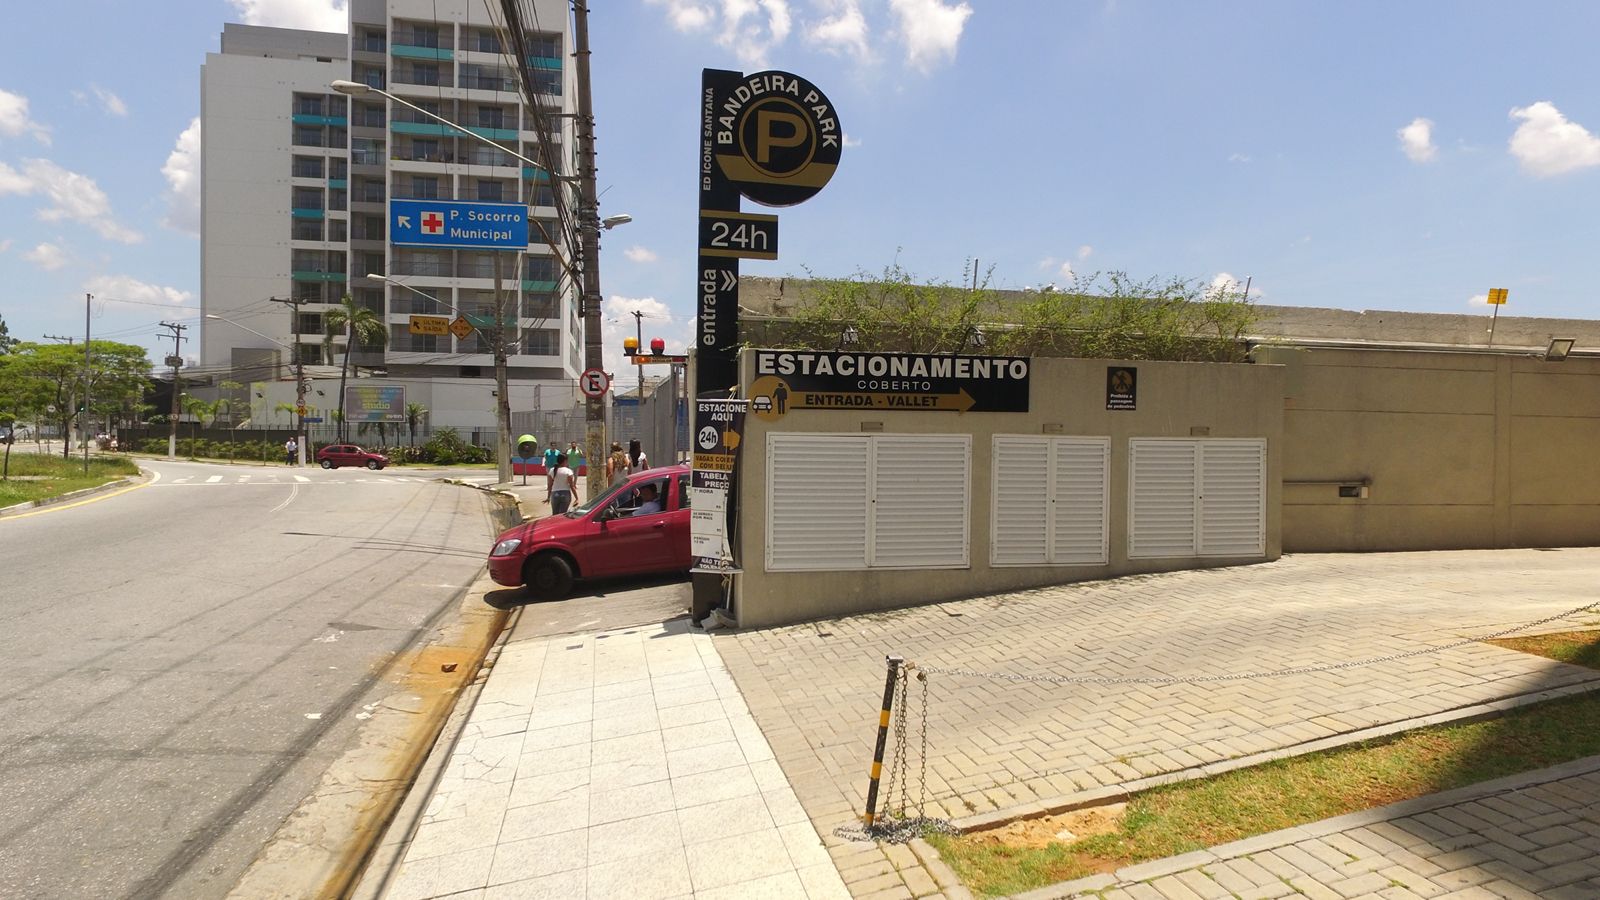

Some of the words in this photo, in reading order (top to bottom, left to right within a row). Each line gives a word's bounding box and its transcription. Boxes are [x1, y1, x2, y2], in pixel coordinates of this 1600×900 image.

[704, 87, 714, 136] SANTANA
[717, 74, 800, 145] BANDEIRA
[804, 89, 838, 149] PARK
[756, 109, 808, 163] P
[703, 176, 711, 191] ED
[450, 210, 464, 221] P.
[468, 211, 521, 222] Socorro
[450, 228, 512, 241] Municipal
[711, 221, 768, 250] 24h
[702, 268, 717, 346] entrada
[758, 353, 1028, 380] ESTACIONAMENTO
[589, 374, 600, 392] E
[857, 380, 931, 391] COBERTO
[805, 394, 873, 406] ENTRADA
[886, 395, 939, 407] VALLET
[698, 403, 747, 413] ESTACIONE
[711, 412, 733, 422] AQUI
[700, 430, 717, 444] 24h
[699, 472, 728, 481] TABELA
